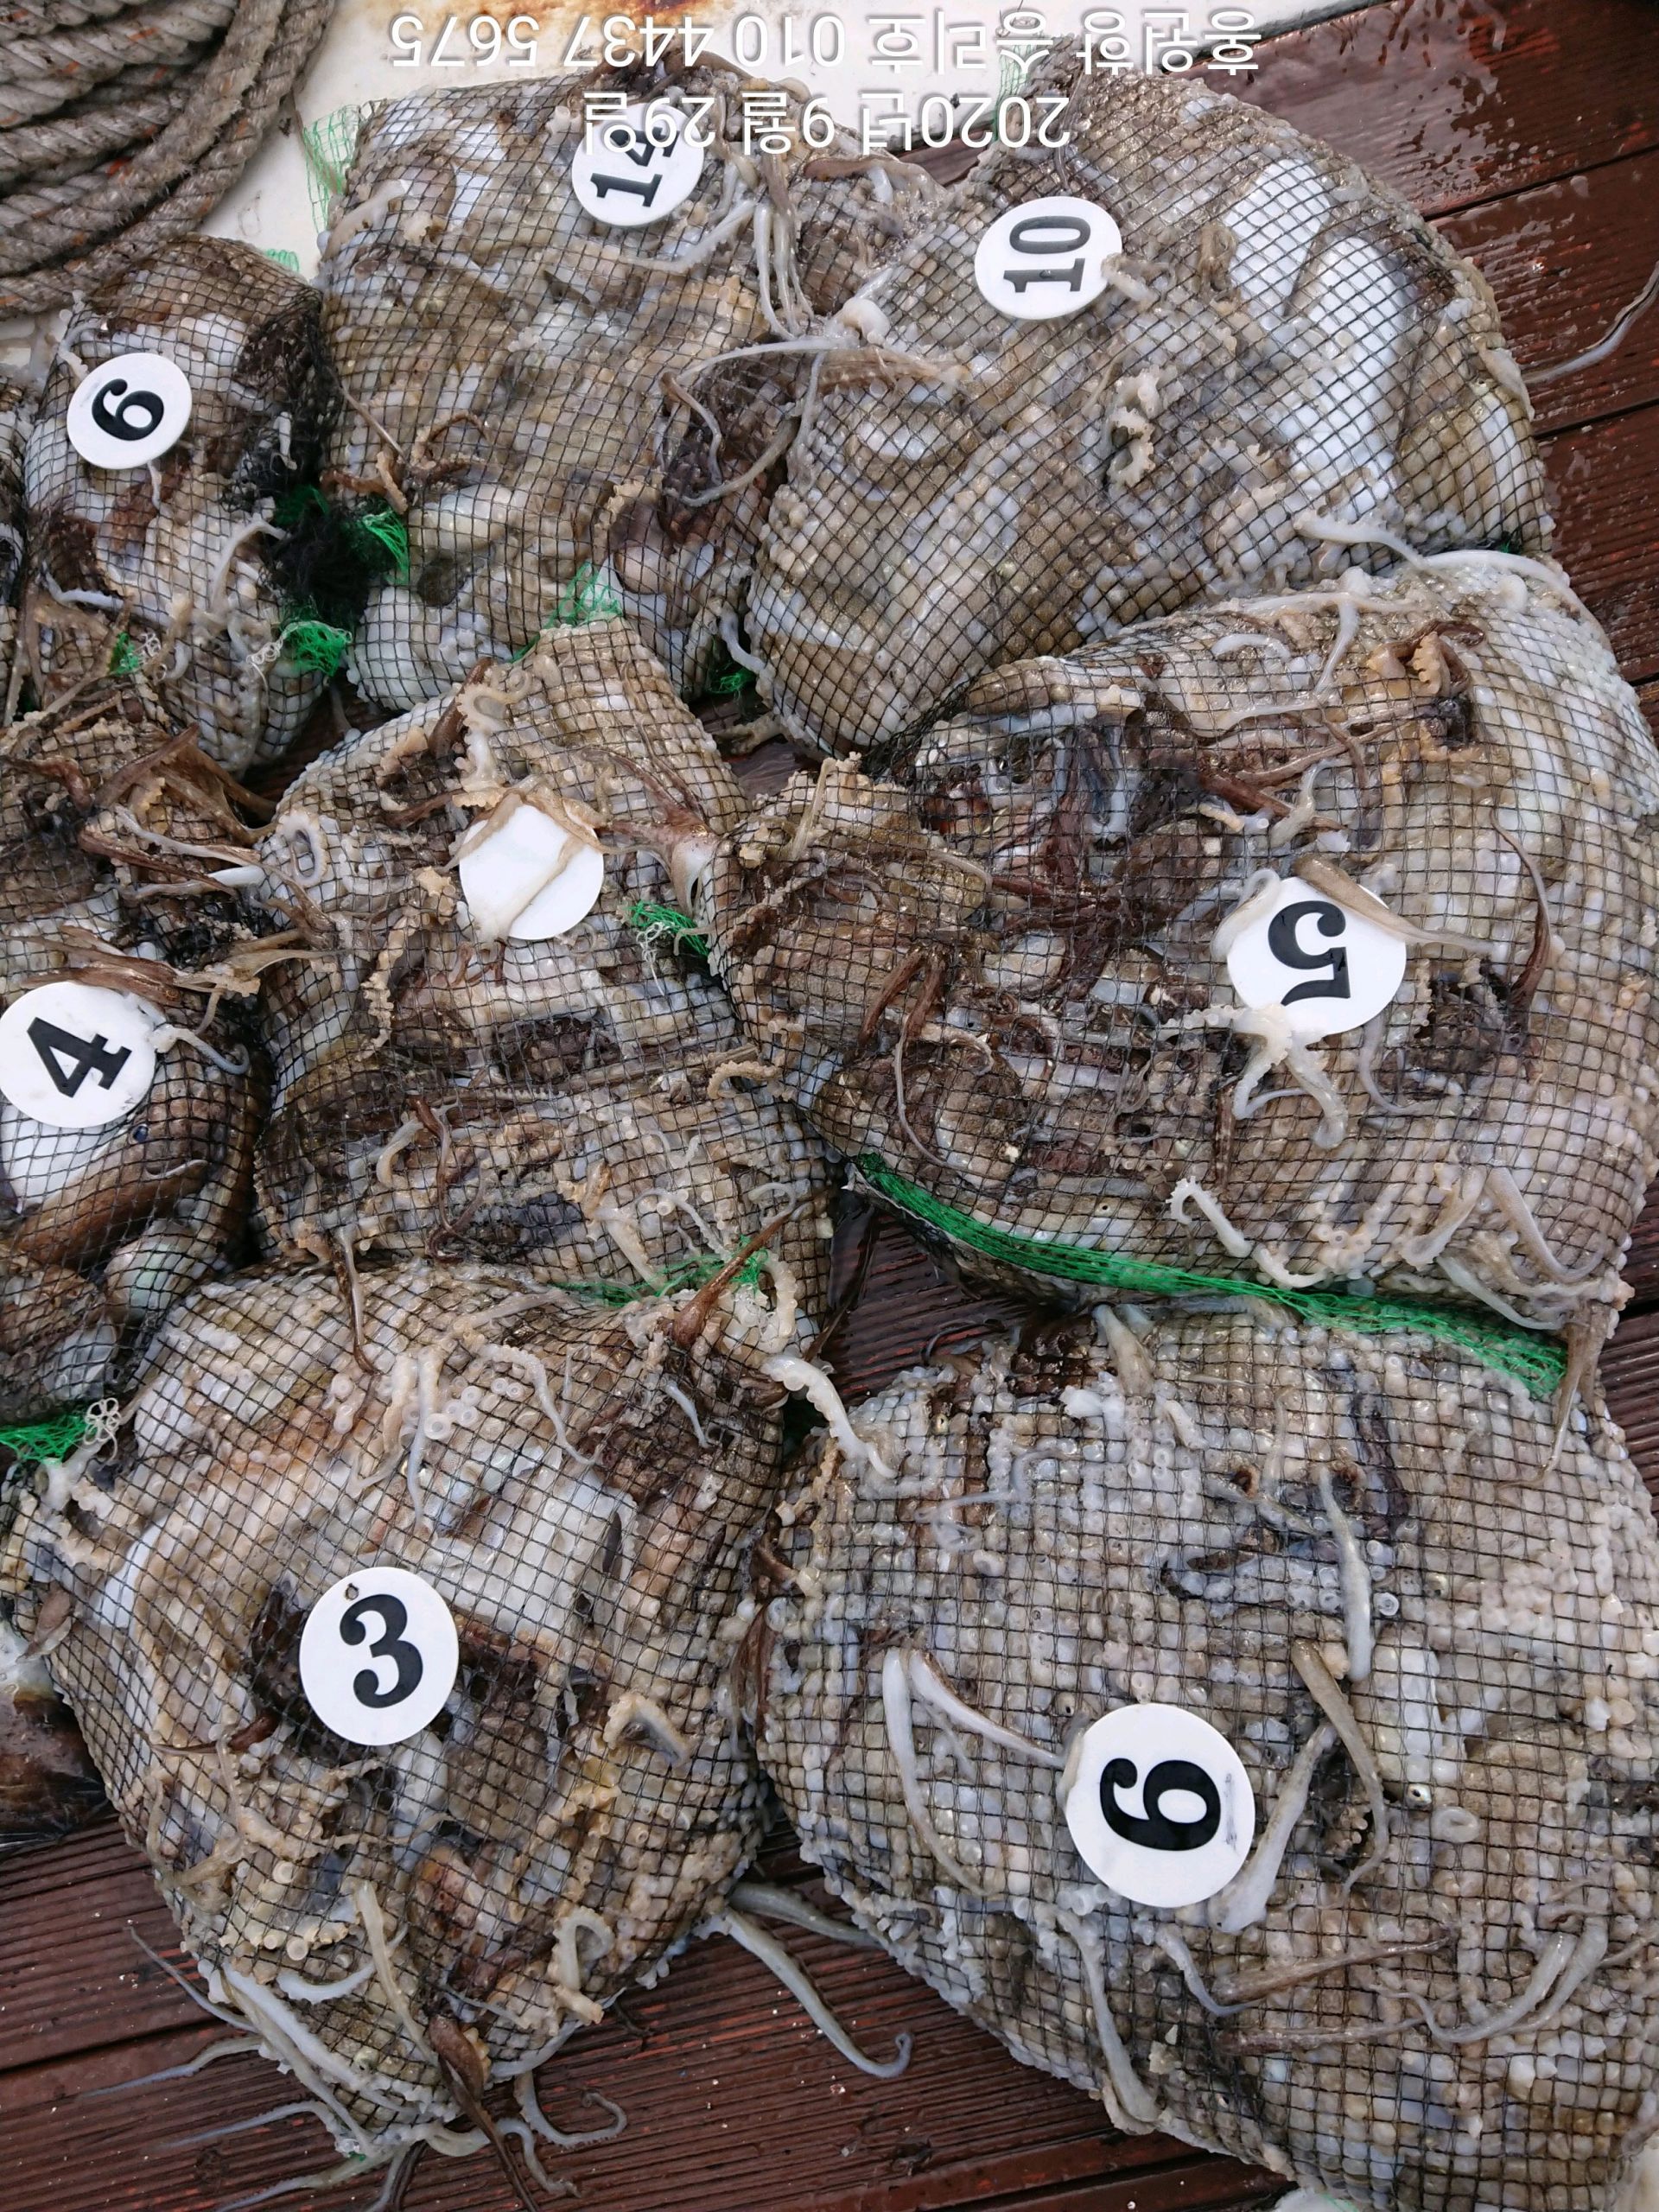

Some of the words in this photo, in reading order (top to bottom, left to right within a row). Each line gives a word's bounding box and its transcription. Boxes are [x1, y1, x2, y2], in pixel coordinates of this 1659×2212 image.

[1003, 213, 1092, 295] 10
[1267, 899, 1351, 1007] 5
[27, 1017, 132, 1098] 4
[340, 1593, 423, 1709] 3
